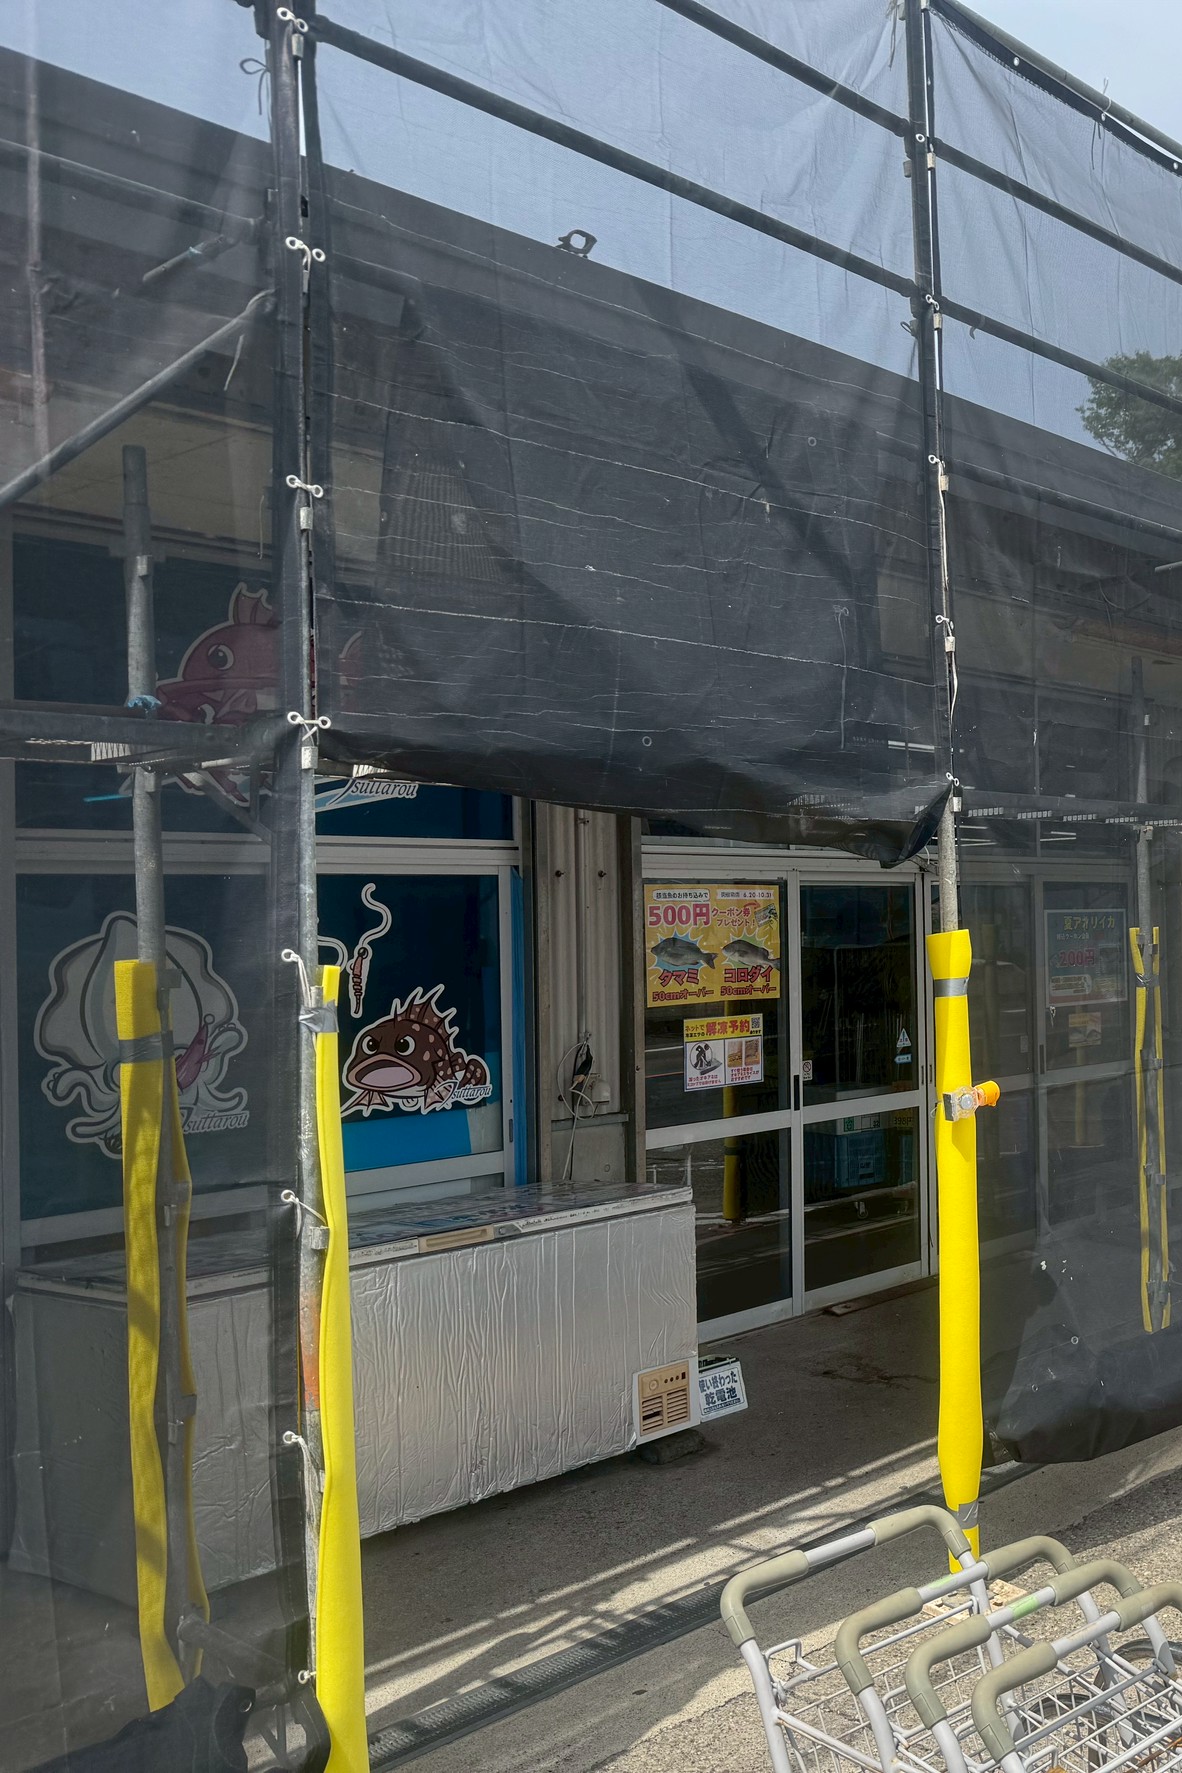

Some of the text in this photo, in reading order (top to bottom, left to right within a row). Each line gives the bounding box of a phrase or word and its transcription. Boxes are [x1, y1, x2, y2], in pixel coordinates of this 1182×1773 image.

[648, 903, 711, 927] 500円
[711, 907, 751, 918] クーポン券
[659, 968, 699, 987] タマミ
[724, 965, 773, 983] コロダイ
[652, 987, 714, 1002] 50cmオーバー
[720, 983, 777, 996] 50cmオーバー
[699, 1371, 738, 1393] 使い終わった
[704, 1385, 738, 1406] 乾電池
